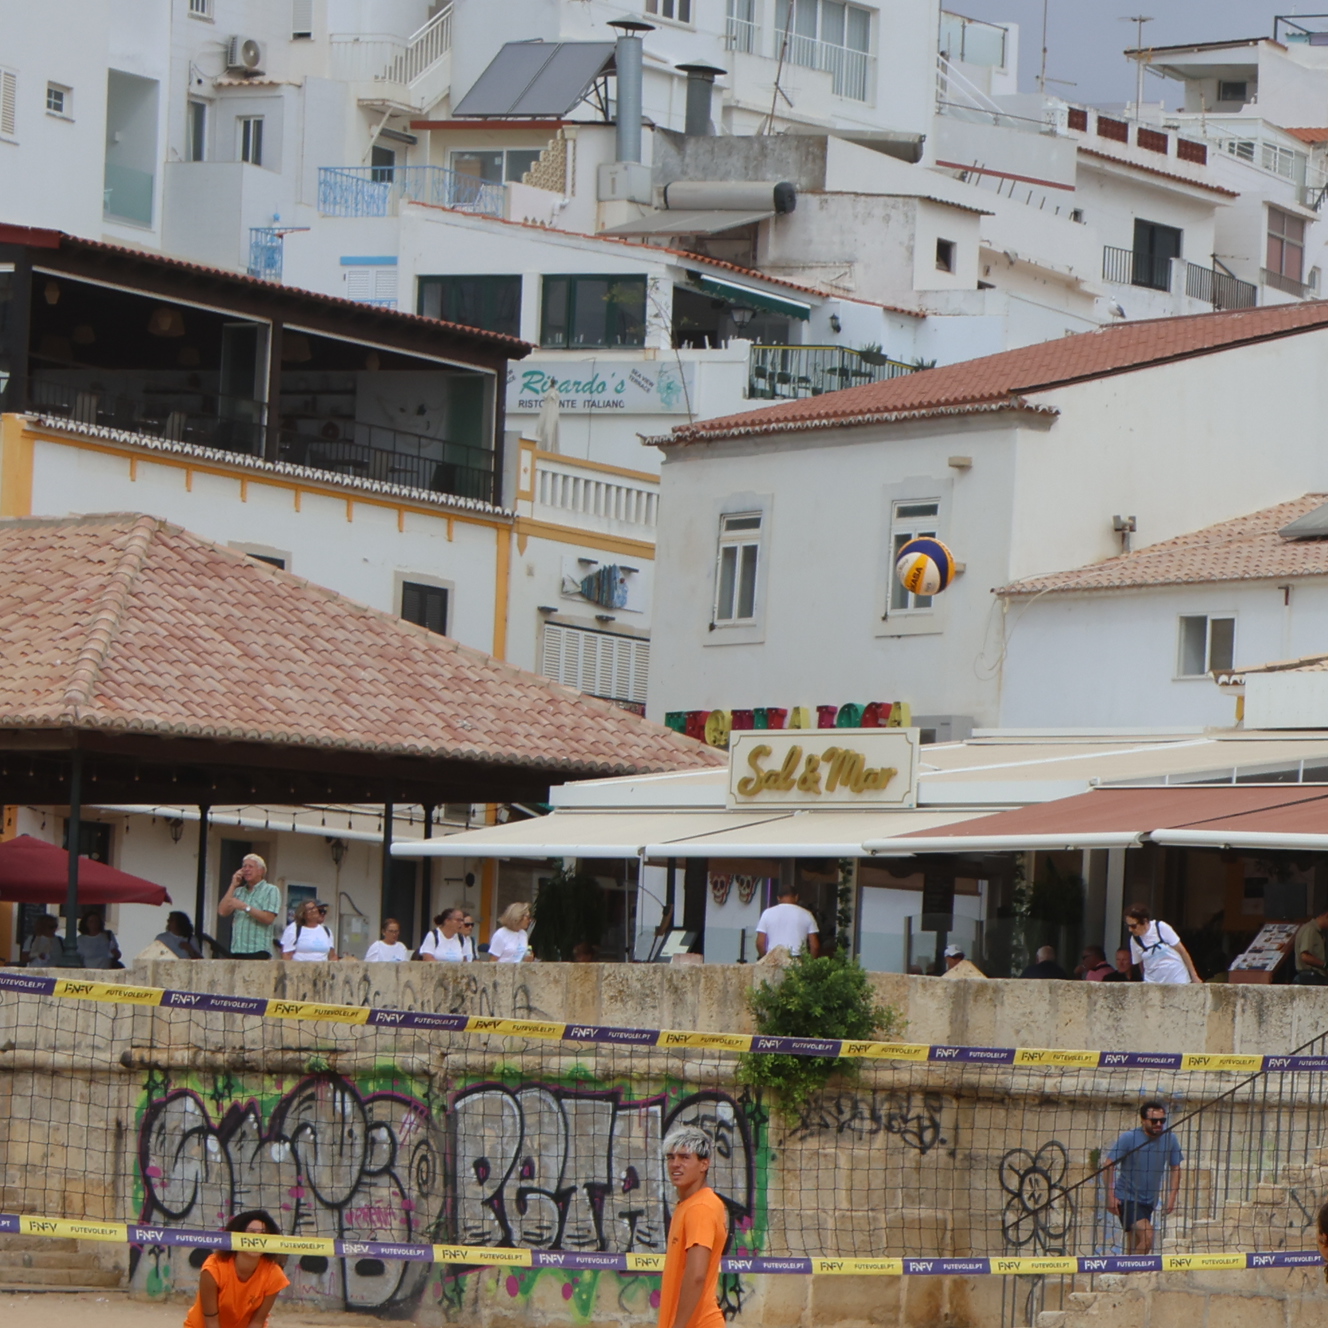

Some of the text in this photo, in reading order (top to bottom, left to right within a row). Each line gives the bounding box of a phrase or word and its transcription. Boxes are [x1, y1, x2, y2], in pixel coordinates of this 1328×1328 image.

[519, 370, 626, 395] Riardo's
[738, 744, 898, 796] Sal & Mar
[0, 977, 46, 989] UTEVOLEI.PT
[70, 1226, 118, 1236] FUTEVOLEI.PT
[175, 1234, 223, 1245] FUTEVOLEI.PT
[279, 1241, 326, 1250] FUTEVOLEI.PT
[380, 1247, 426, 1257] FUTEVOLEI.PT
[479, 1252, 523, 1261] FUTEVOLEI.PT
[576, 1256, 619, 1265] FUTEVOLEI.PT
